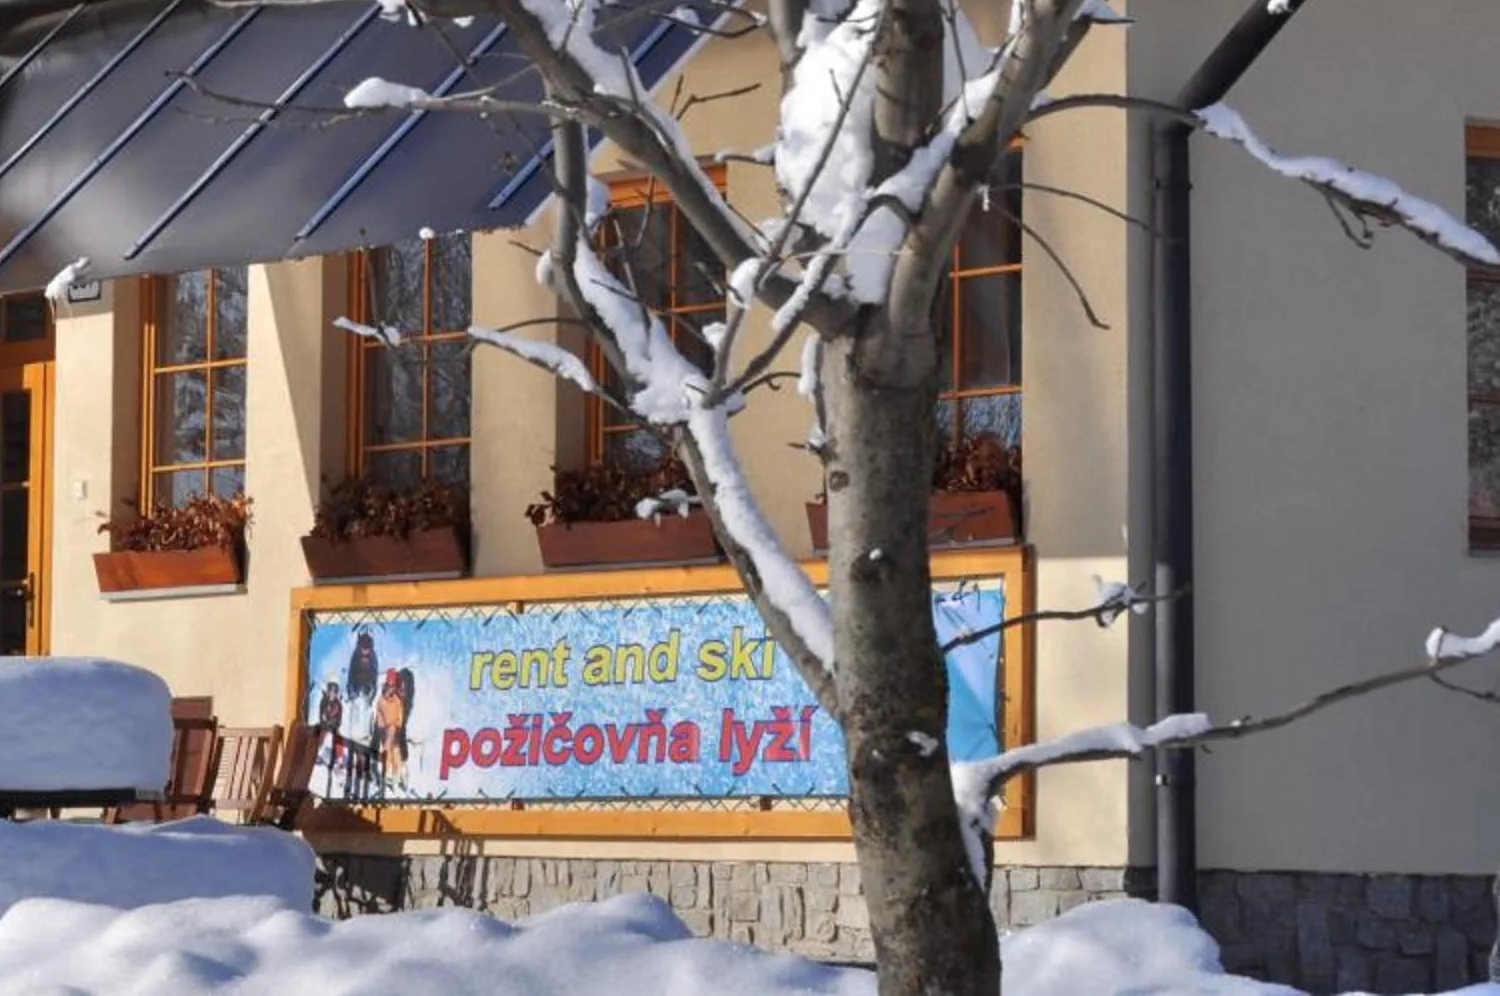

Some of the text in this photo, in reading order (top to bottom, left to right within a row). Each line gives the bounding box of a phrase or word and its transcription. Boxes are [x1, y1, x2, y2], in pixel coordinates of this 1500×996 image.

[470, 626, 776, 690] rent and ski
[440, 704, 820, 780] požičovňa lyží
